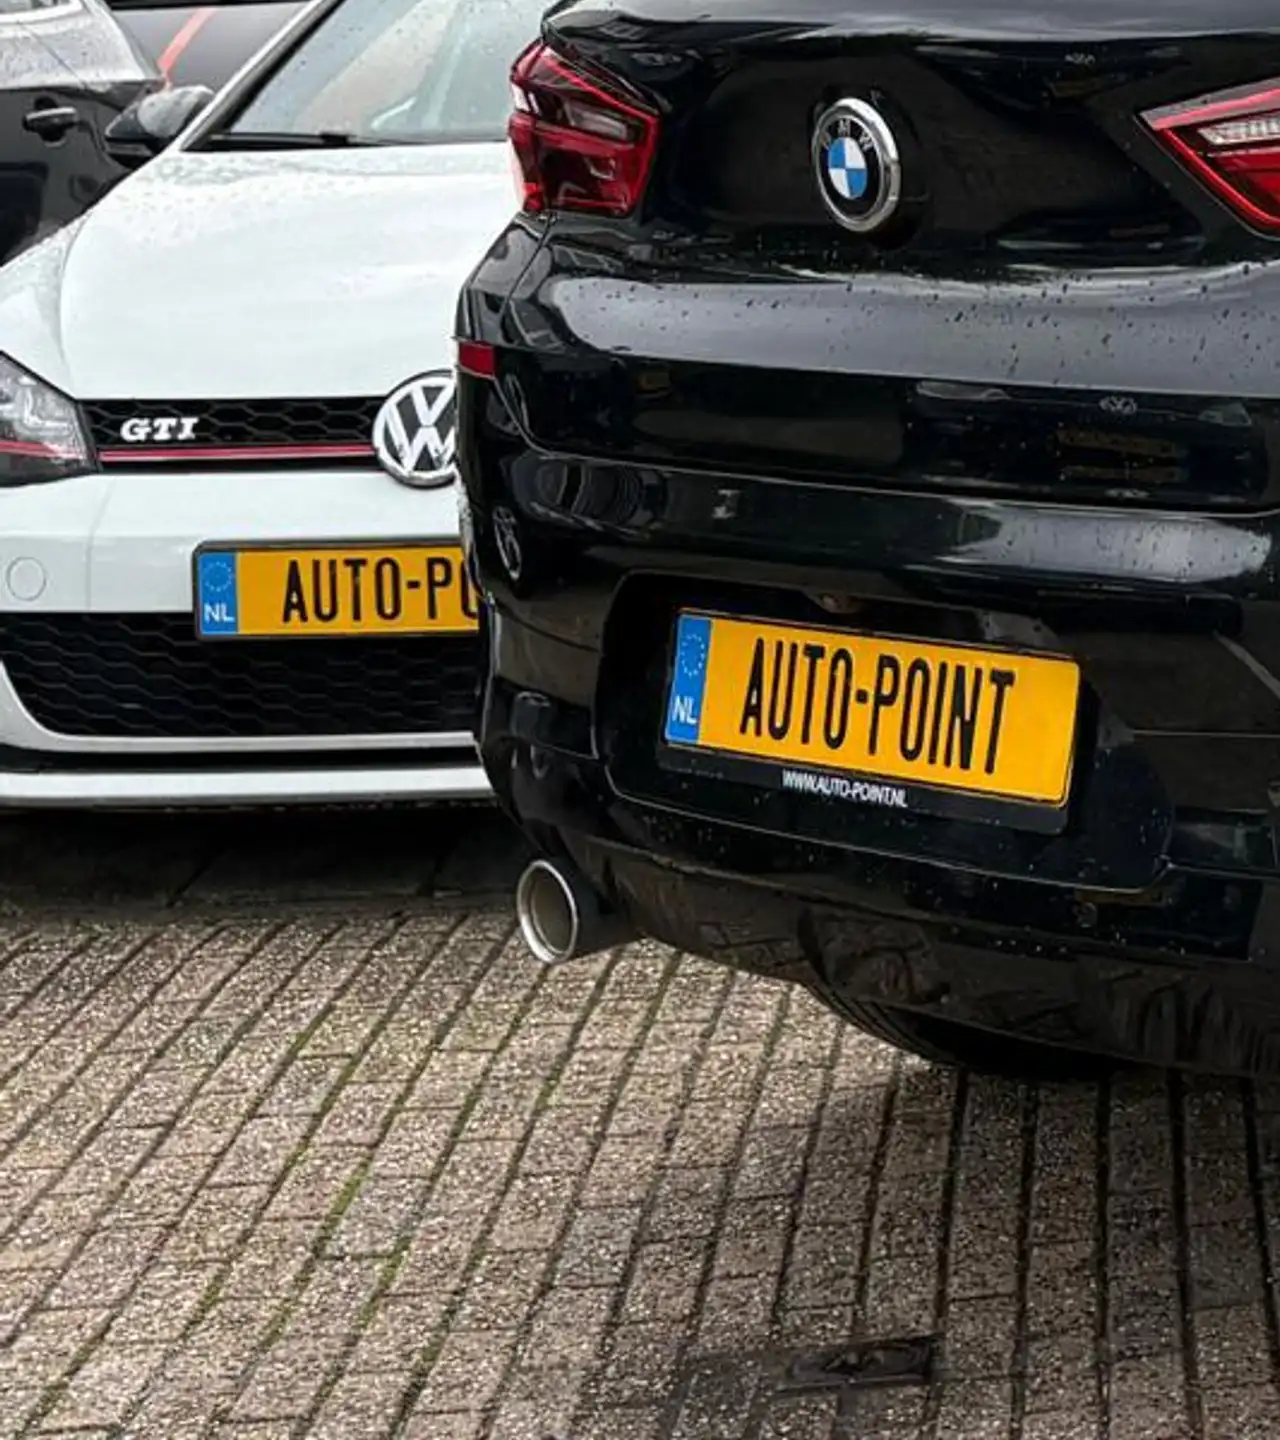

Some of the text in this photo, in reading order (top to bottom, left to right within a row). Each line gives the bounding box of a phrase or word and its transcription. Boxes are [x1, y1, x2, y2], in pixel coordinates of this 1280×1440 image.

[119, 417, 199, 442] GTI
[203, 602, 235, 623] NL
[671, 636, 1016, 776] NL AUTO-POINT
